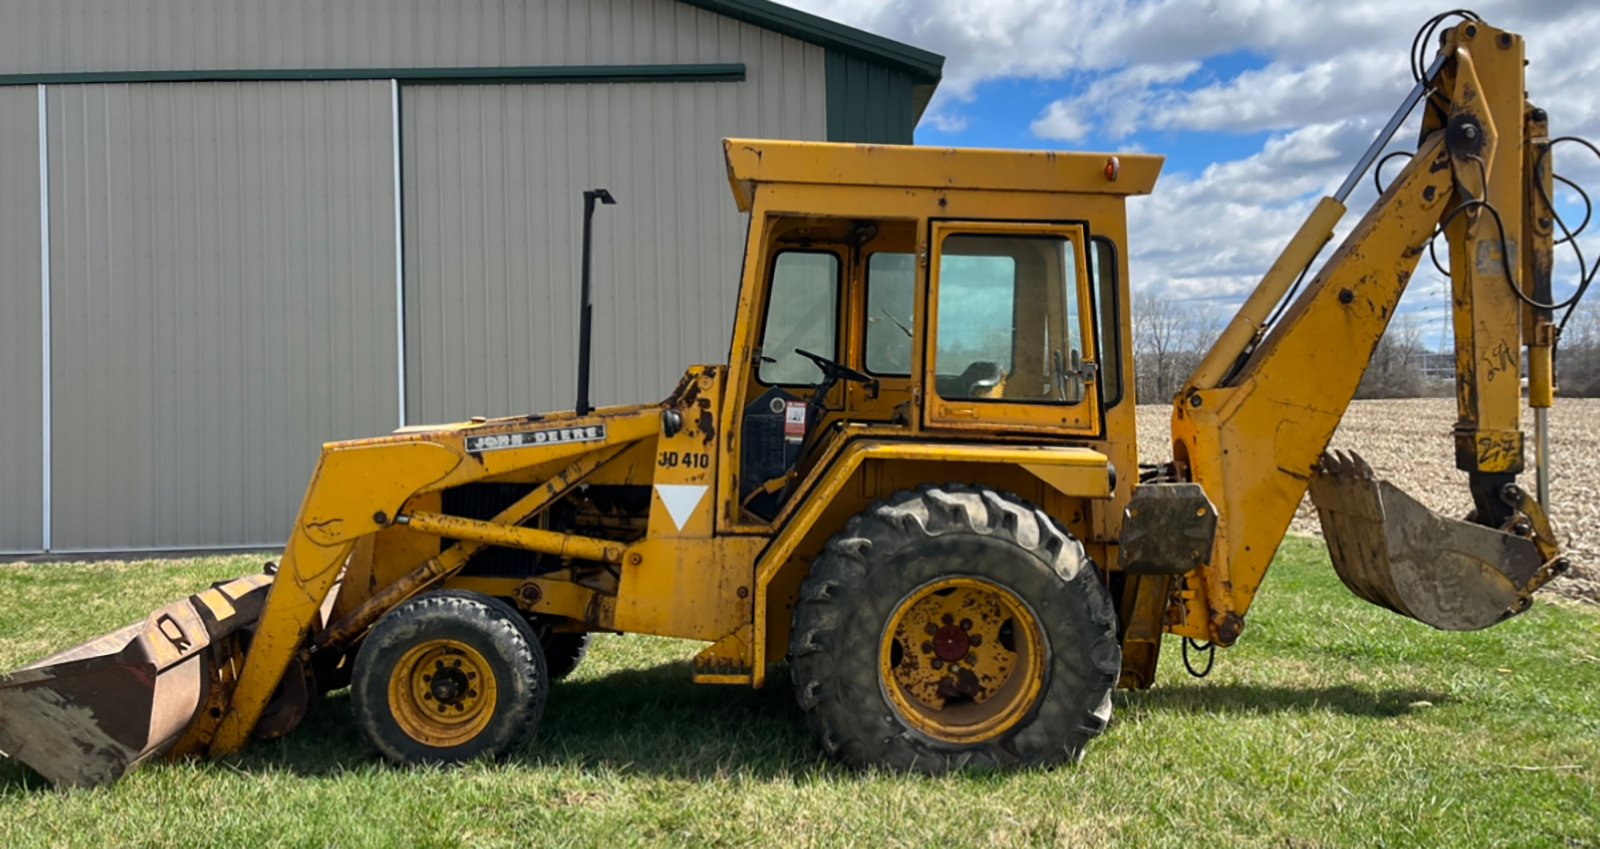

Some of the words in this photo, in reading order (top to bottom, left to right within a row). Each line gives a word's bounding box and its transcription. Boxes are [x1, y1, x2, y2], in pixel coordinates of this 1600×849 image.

[474, 434, 523, 449] JOHN
[534, 426, 598, 443] DEERE
[657, 451, 679, 468] JD
[681, 452, 710, 469] 410
